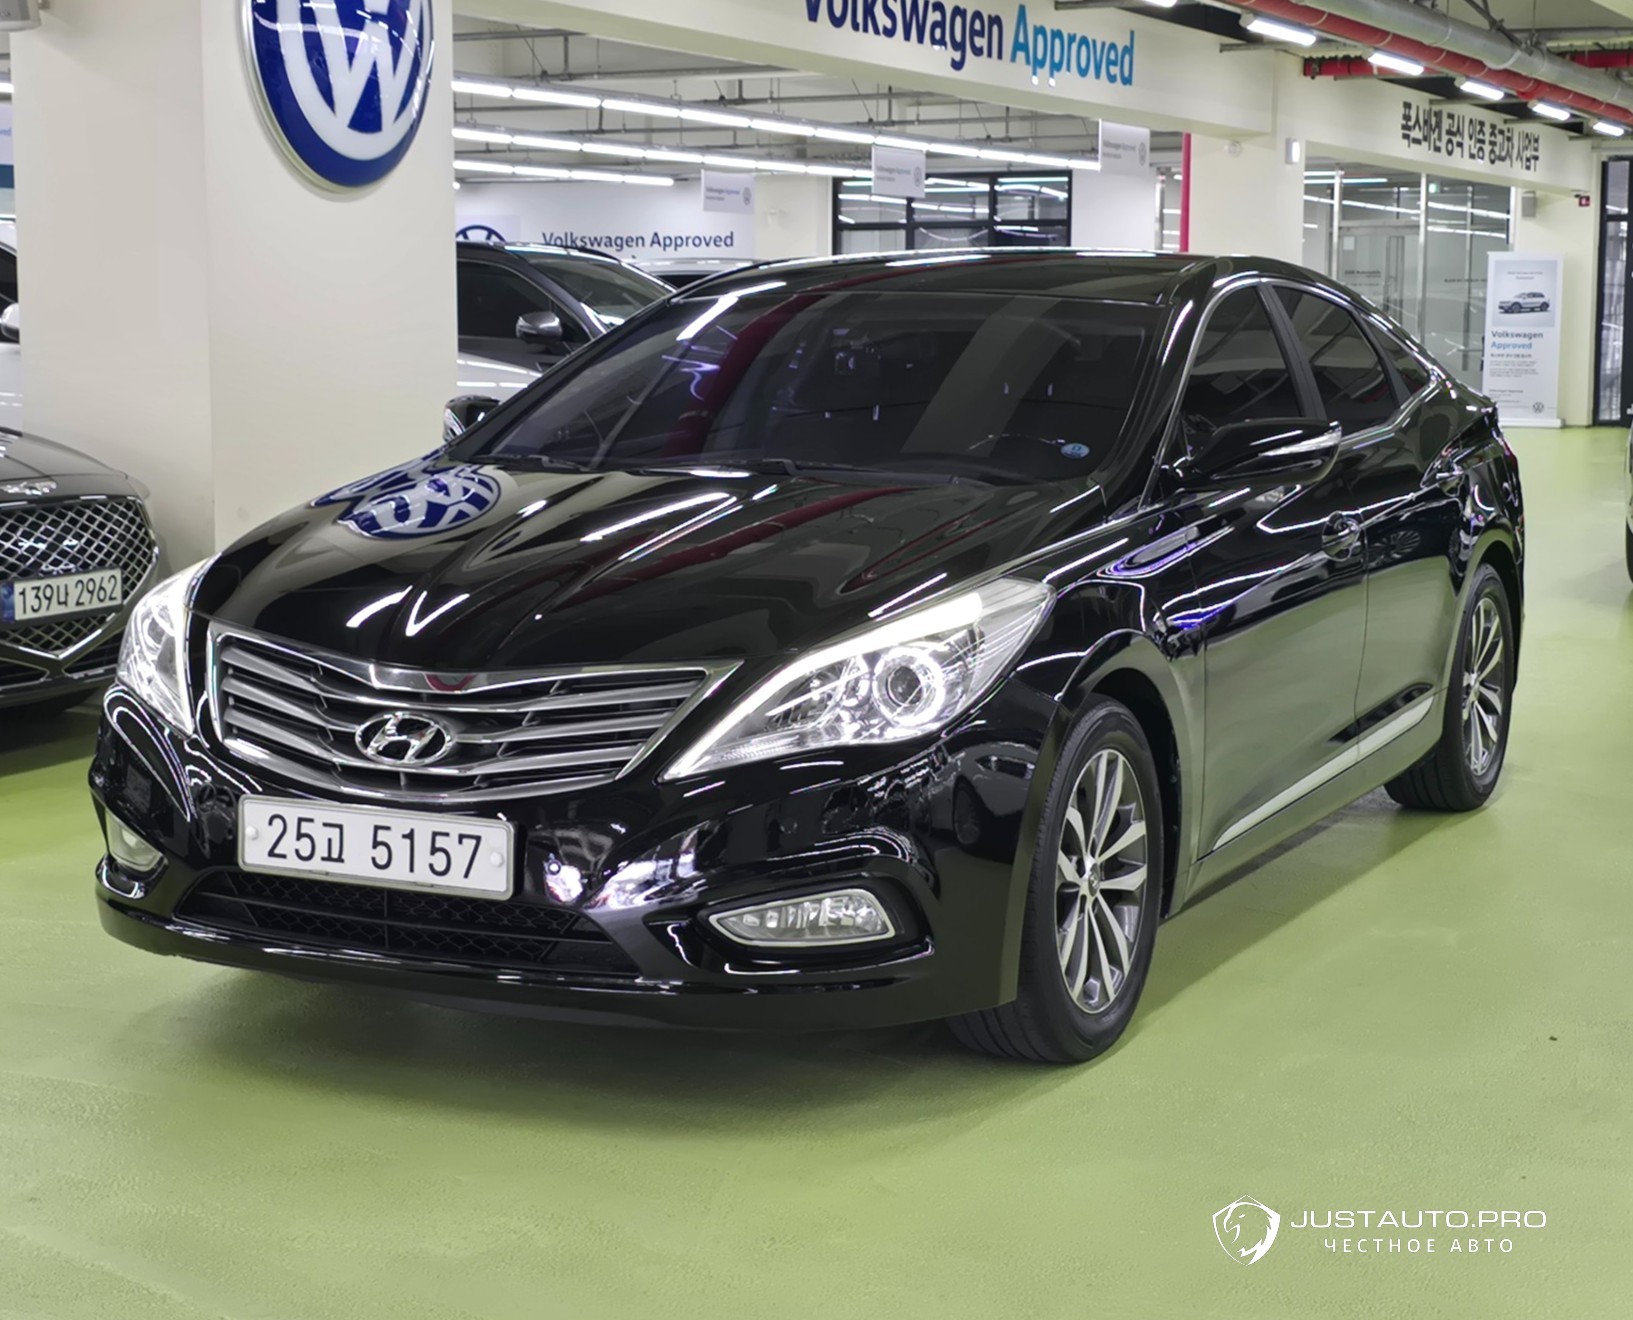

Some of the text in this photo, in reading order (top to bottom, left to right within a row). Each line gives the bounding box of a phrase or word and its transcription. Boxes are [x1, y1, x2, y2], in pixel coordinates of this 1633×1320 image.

[1009, 3, 1135, 87] Approved
[1401, 101, 1540, 172] 폭스바겐 공식 인증 중고차 사업부
[542, 231, 734, 252] Volkswagen Approved
[1490, 341, 1533, 350] Approved
[1491, 330, 1544, 340] Volkswagen
[19, 574, 118, 615] 139나 2962
[266, 813, 482, 879] 25고 5157
